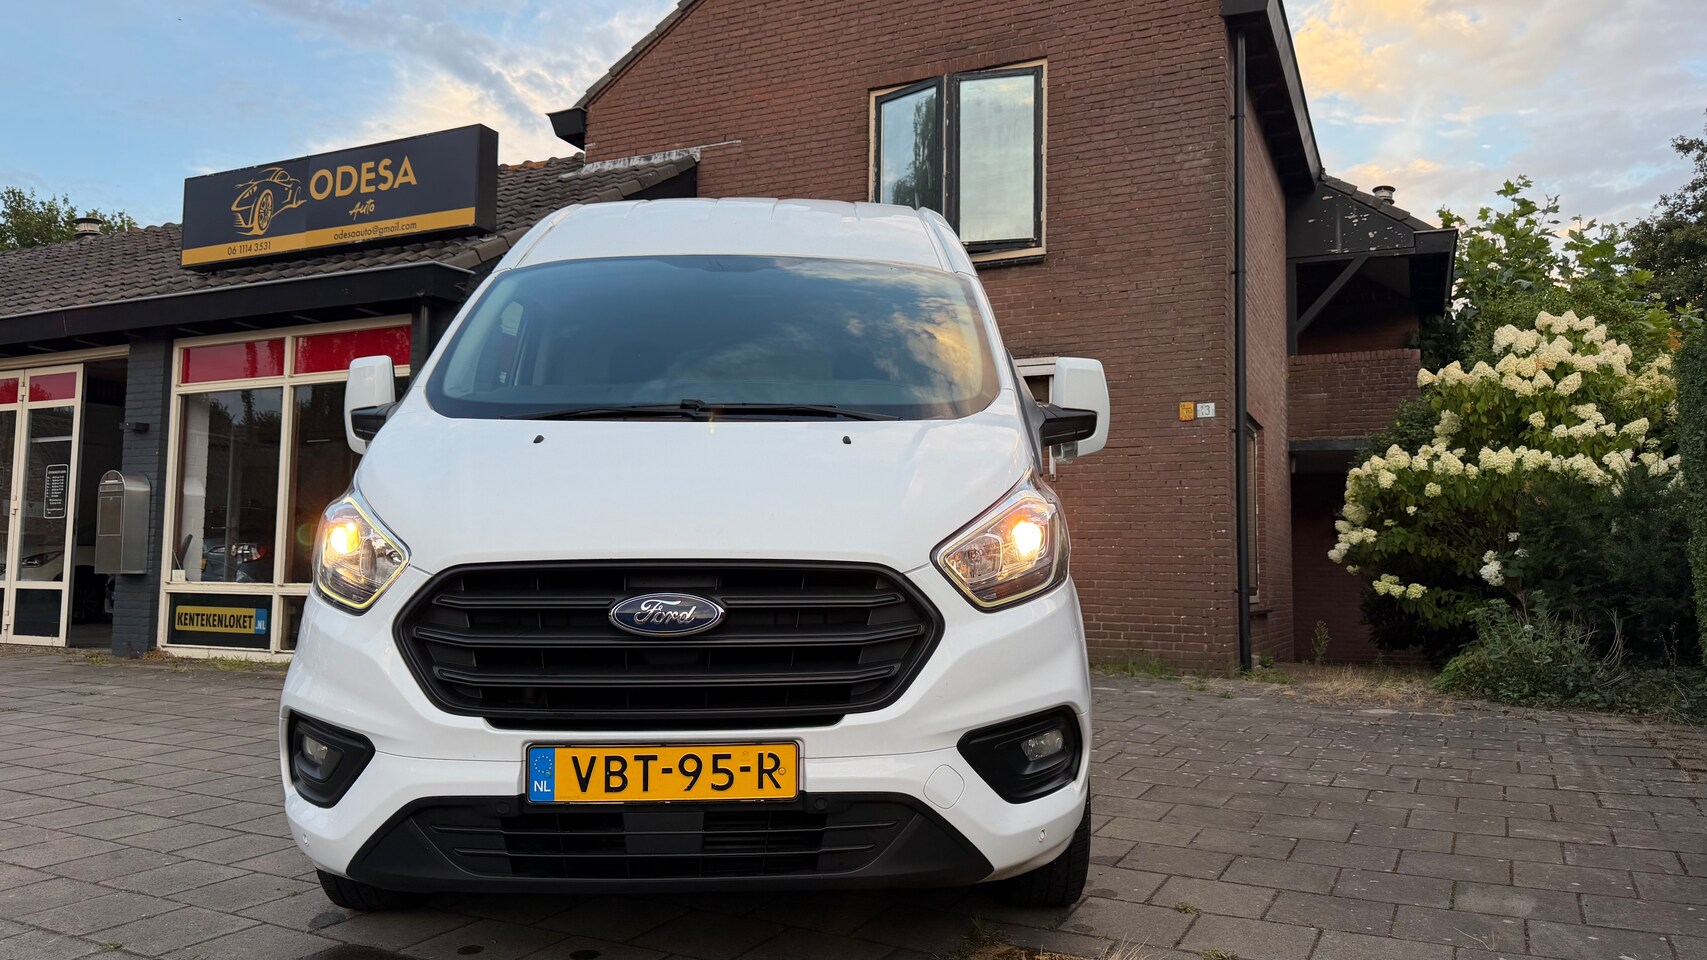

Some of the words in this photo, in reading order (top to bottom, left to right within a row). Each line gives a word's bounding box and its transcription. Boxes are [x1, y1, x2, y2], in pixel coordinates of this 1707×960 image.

[309, 155, 418, 201] ODESA
[348, 198, 375, 221] Auto
[333, 221, 417, 240] odesaauto@gmail.com
[227, 246, 237, 256] 06
[239, 244, 253, 254] 1114
[254, 241, 271, 252] 3531
[633, 599, 697, 625] Ford
[571, 752, 782, 793] VBT-95-R
[534, 780, 552, 792] NL
